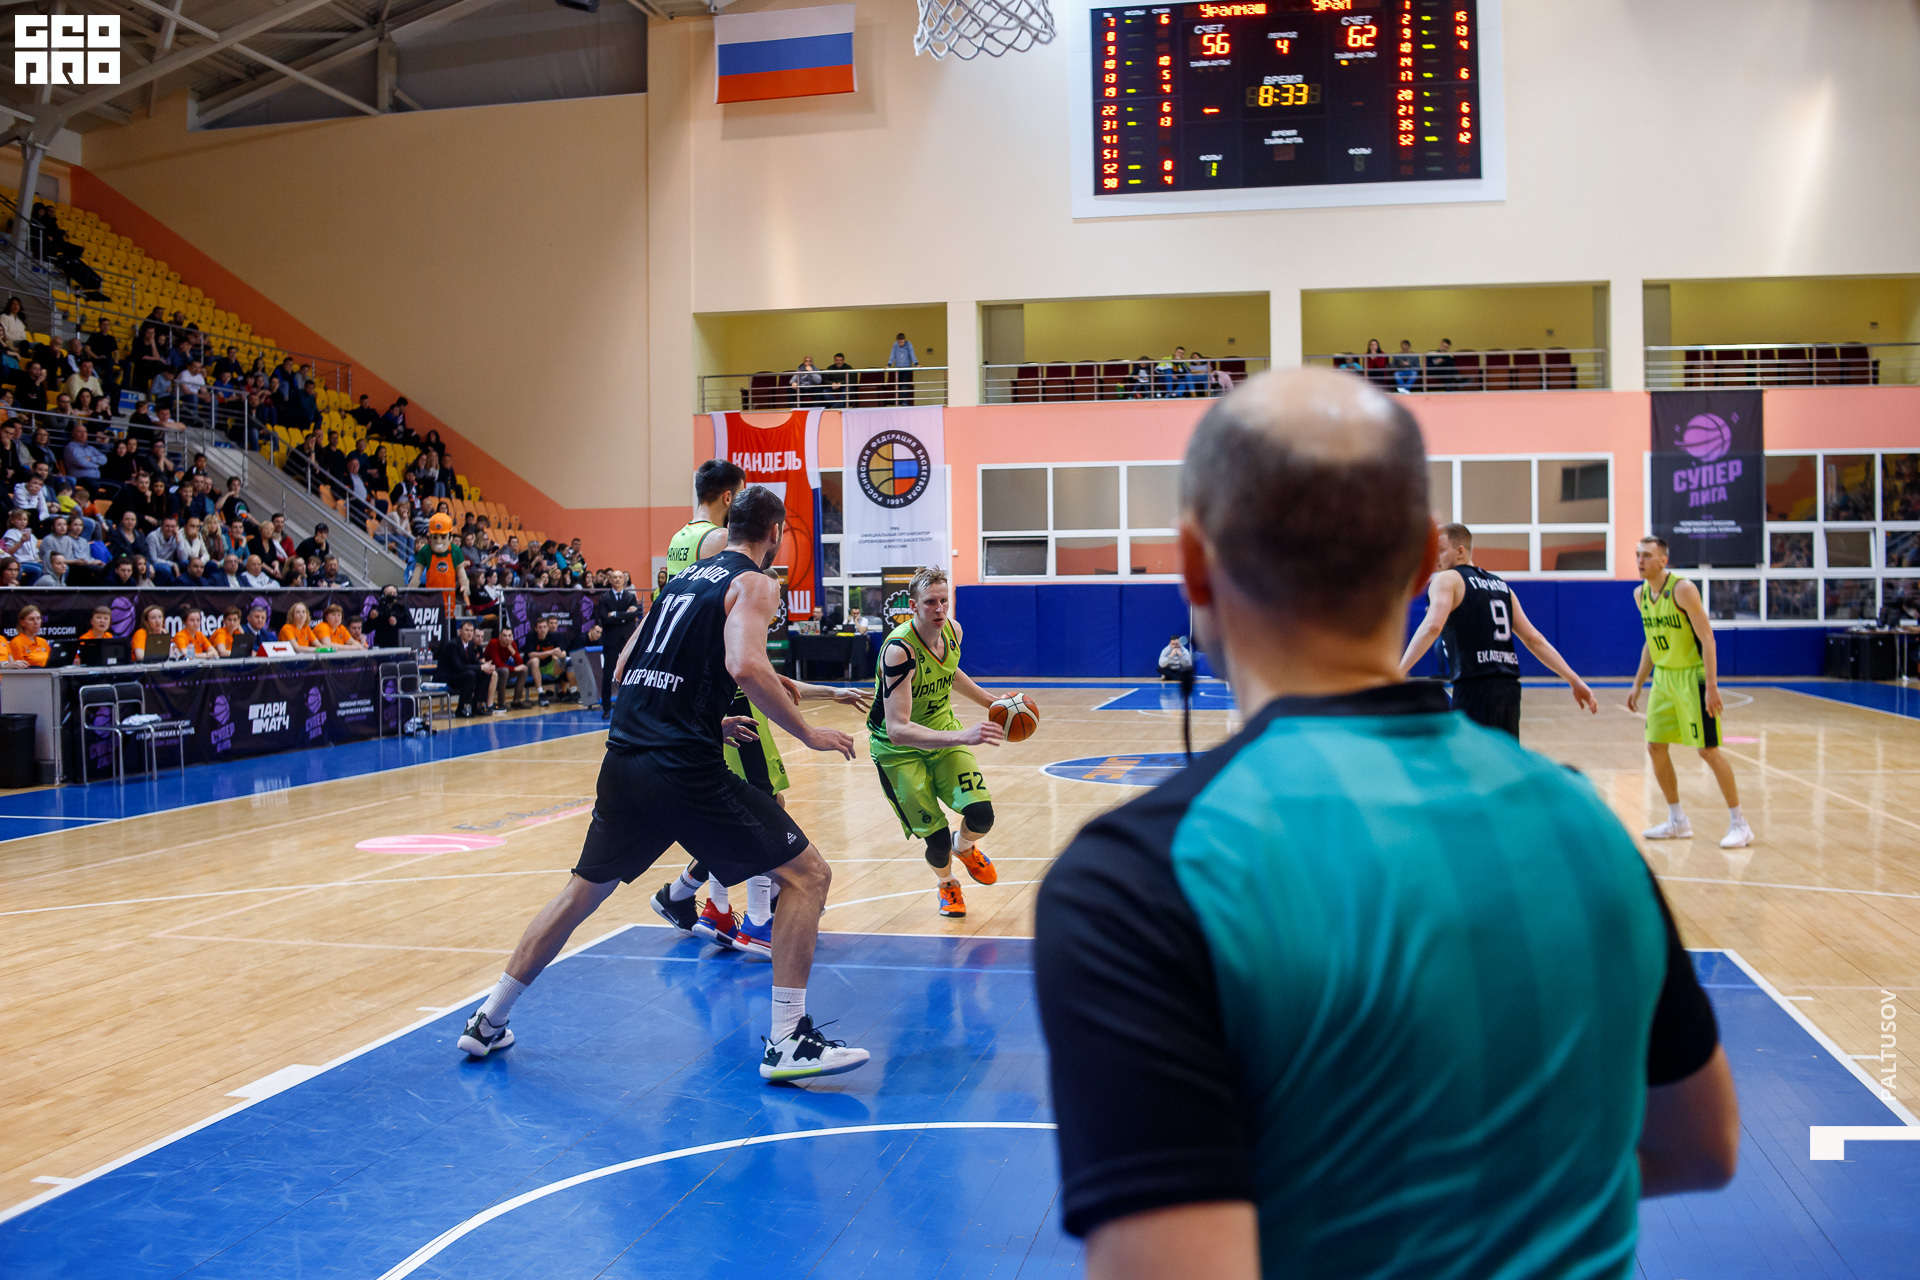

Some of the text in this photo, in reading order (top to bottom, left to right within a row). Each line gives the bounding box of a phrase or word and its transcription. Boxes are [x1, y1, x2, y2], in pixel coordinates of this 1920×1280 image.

[1160, 13, 1170, 25] 6
[1341, 15, 1373, 26] СЧЕТ
[1194, 24, 1225, 34] СЧЕТ
[1347, 25, 1377, 47] 62
[1202, 33, 1230, 55] 56
[1276, 39, 1289, 54] 4
[1161, 69, 1172, 80] 5
[1263, 74, 1304, 86] ВРЕМЯ
[1460, 67, 1470, 80] 6
[1258, 84, 1309, 107] 8:33
[1101, 101, 1172, 116] 22 6
[1460, 101, 1471, 114] 6
[1460, 116, 1471, 129] 6
[1163, 160, 1174, 171] 8
[732, 451, 802, 474] КАНДЕЛЬ
[860, 434, 928, 502] РОССИЙСКАЯ ФЕДЕРАЦИЯ БАСКЕТБОЛА
[1673, 459, 1742, 494] СУПЕР
[1689, 486, 1728, 508] ЛИГА
[645, 593, 696, 655] 17
[1489, 599, 1511, 642] 9
[48, 626, 76, 636] РОССИИ
[1652, 636, 1670, 651] 10
[248, 701, 287, 720] ПАРИ
[252, 715, 290, 735] МАТЧ
[957, 772, 986, 794] 52
